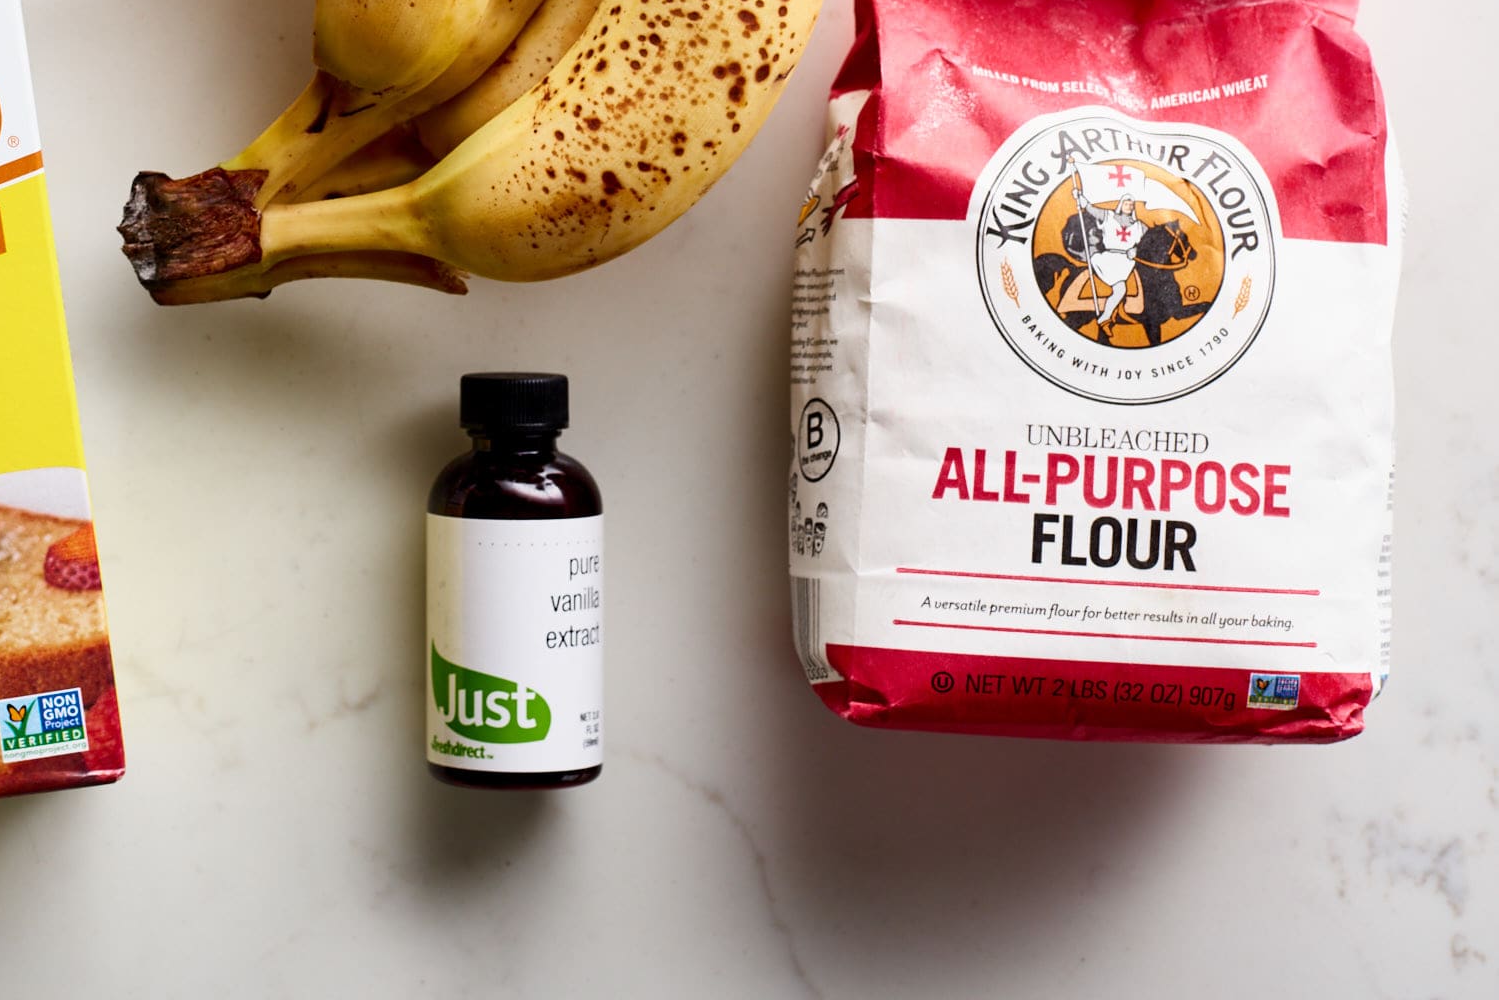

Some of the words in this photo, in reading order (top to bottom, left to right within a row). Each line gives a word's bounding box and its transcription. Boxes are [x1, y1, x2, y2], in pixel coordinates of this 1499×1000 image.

[972, 64, 1020, 86] MILLED
[1021, 76, 1060, 93] FROM
[1062, 80, 1110, 98] SELECT
[1111, 92, 1148, 112] 100%
[1150, 86, 1221, 111] AMERICAN
[1221, 73, 1270, 98] WHEAT
[985, 159, 1051, 250] KING
[1051, 127, 1191, 175] ARTHUR
[1191, 149, 1260, 262] FLOUR
[1021, 314, 1066, 359] BAKING
[1071, 356, 1109, 378] WITH
[1117, 369, 1143, 381] JOY
[1151, 355, 1195, 379] SINCE
[1198, 326, 1230, 357] 1790
[807, 411, 824, 449] B
[1026, 423, 1210, 456] UNBLEACHED
[931, 446, 1292, 519] ALL-PURPOSE
[1030, 512, 1198, 574] FLOUR
[568, 551, 601, 581] pure
[550, 586, 601, 614] vanilla
[921, 595, 933, 609] A
[935, 600, 988, 613] versatile
[989, 603, 1047, 618] premium
[1047, 602, 1081, 620] flour
[1082, 605, 1102, 622] for
[1104, 607, 1141, 622] better
[1143, 608, 1184, 624] results
[1186, 611, 1199, 624] in
[1200, 611, 1217, 625] all
[1218, 616, 1250, 629] your
[1251, 614, 1295, 632] baking.
[545, 621, 601, 650] extract
[42, 693, 77, 709] NON
[438, 673, 538, 730] Just
[964, 673, 1006, 695] NET
[1013, 676, 1047, 696] WT
[1052, 678, 1066, 697] 2
[1070, 679, 1108, 700] LBS
[1113, 680, 1144, 702] (32
[1152, 683, 1183, 707] OZ)
[1189, 685, 1236, 711] 907g
[43, 705, 79, 720] GMO
[45, 717, 80, 730] Project
[6, 729, 82, 749] VERIFIED
